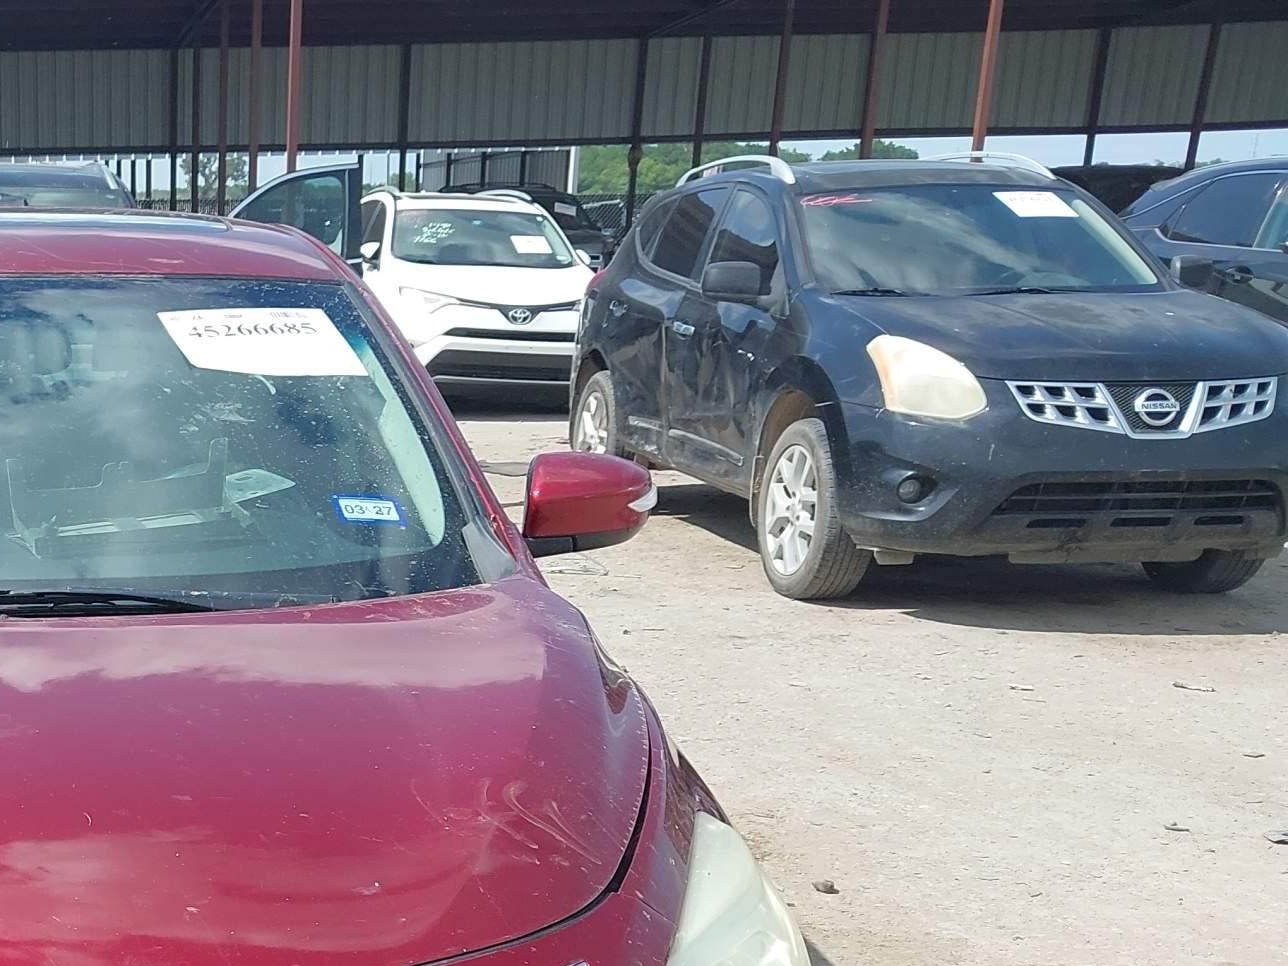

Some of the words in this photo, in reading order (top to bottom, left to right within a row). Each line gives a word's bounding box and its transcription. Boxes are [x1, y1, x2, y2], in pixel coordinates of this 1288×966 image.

[188, 322, 317, 338] 45266685
[1141, 402, 1177, 410] NISSAN
[372, 505, 392, 516] 27
